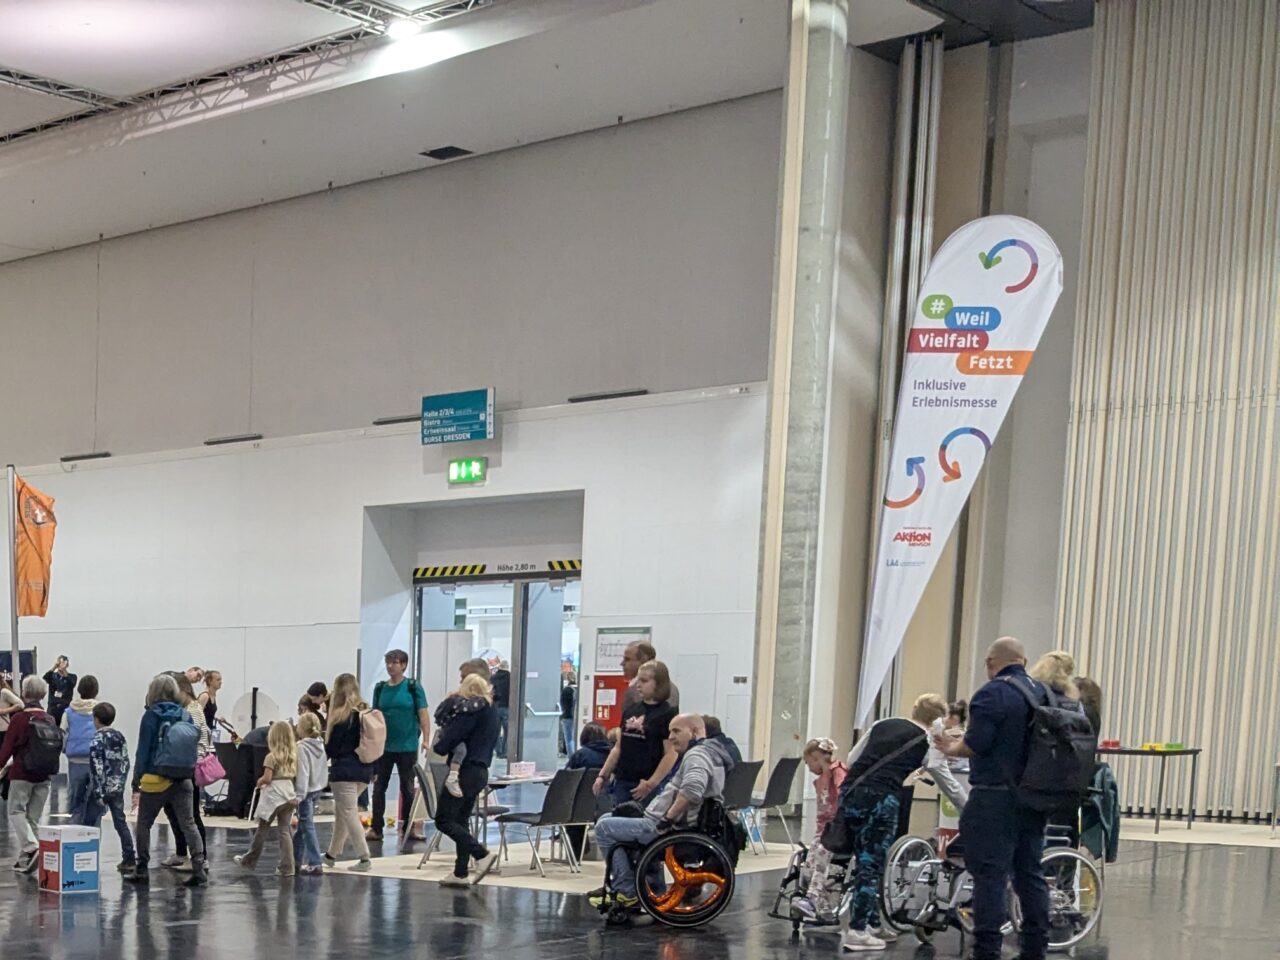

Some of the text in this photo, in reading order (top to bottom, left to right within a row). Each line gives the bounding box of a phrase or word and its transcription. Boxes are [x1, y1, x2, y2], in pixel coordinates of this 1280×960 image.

[955, 311, 990, 326] Weil
[918, 333, 980, 348] Vielfalt
[969, 355, 1013, 369] Fetzt
[913, 379, 967, 391] Inklusive
[912, 396, 998, 408] Erlebnismesse
[443, 432, 471, 442] DRESDEN
